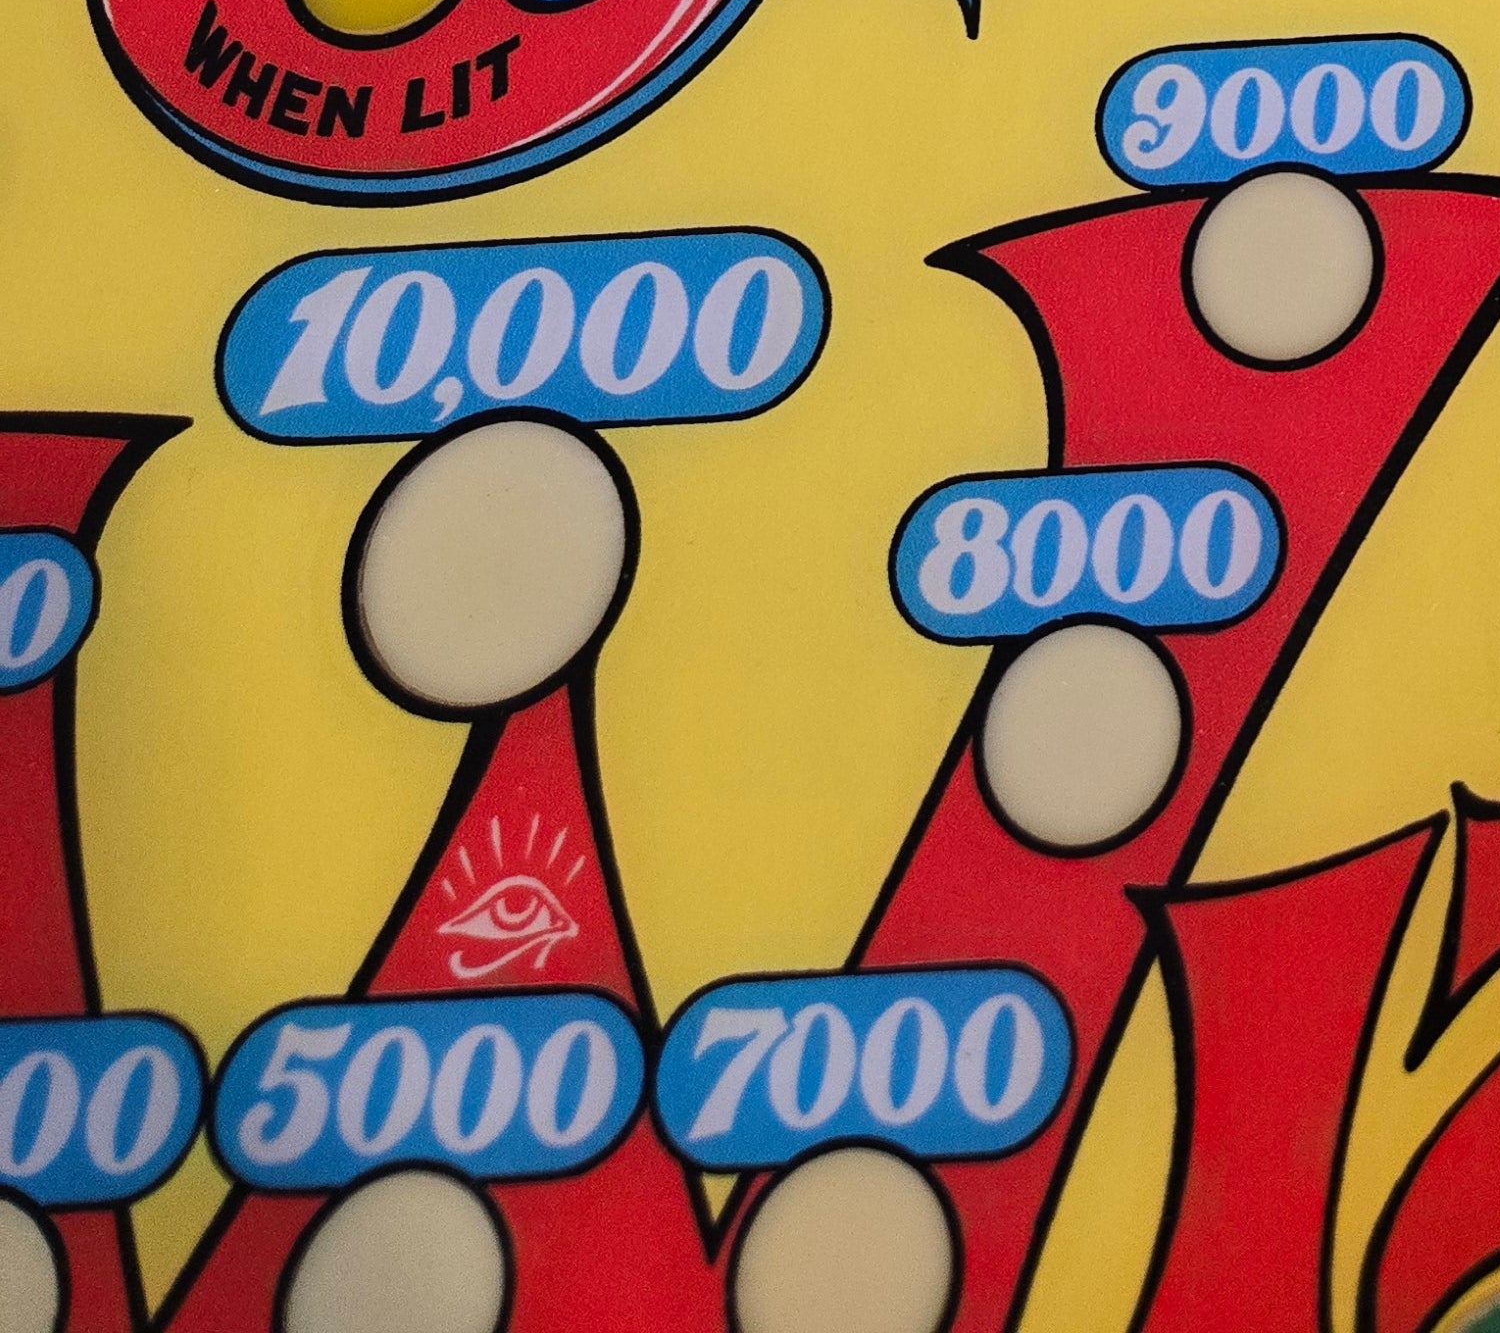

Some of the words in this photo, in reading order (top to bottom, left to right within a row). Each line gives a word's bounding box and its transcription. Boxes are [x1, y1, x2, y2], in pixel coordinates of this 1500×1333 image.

[400, 34, 522, 135] LIT
[1120, 59, 1446, 170] 9000
[258, 254, 805, 423] 10,000
[917, 487, 1265, 617] 8000
[242, 1016, 618, 1167] 5000
[687, 991, 1047, 1142] 7000
